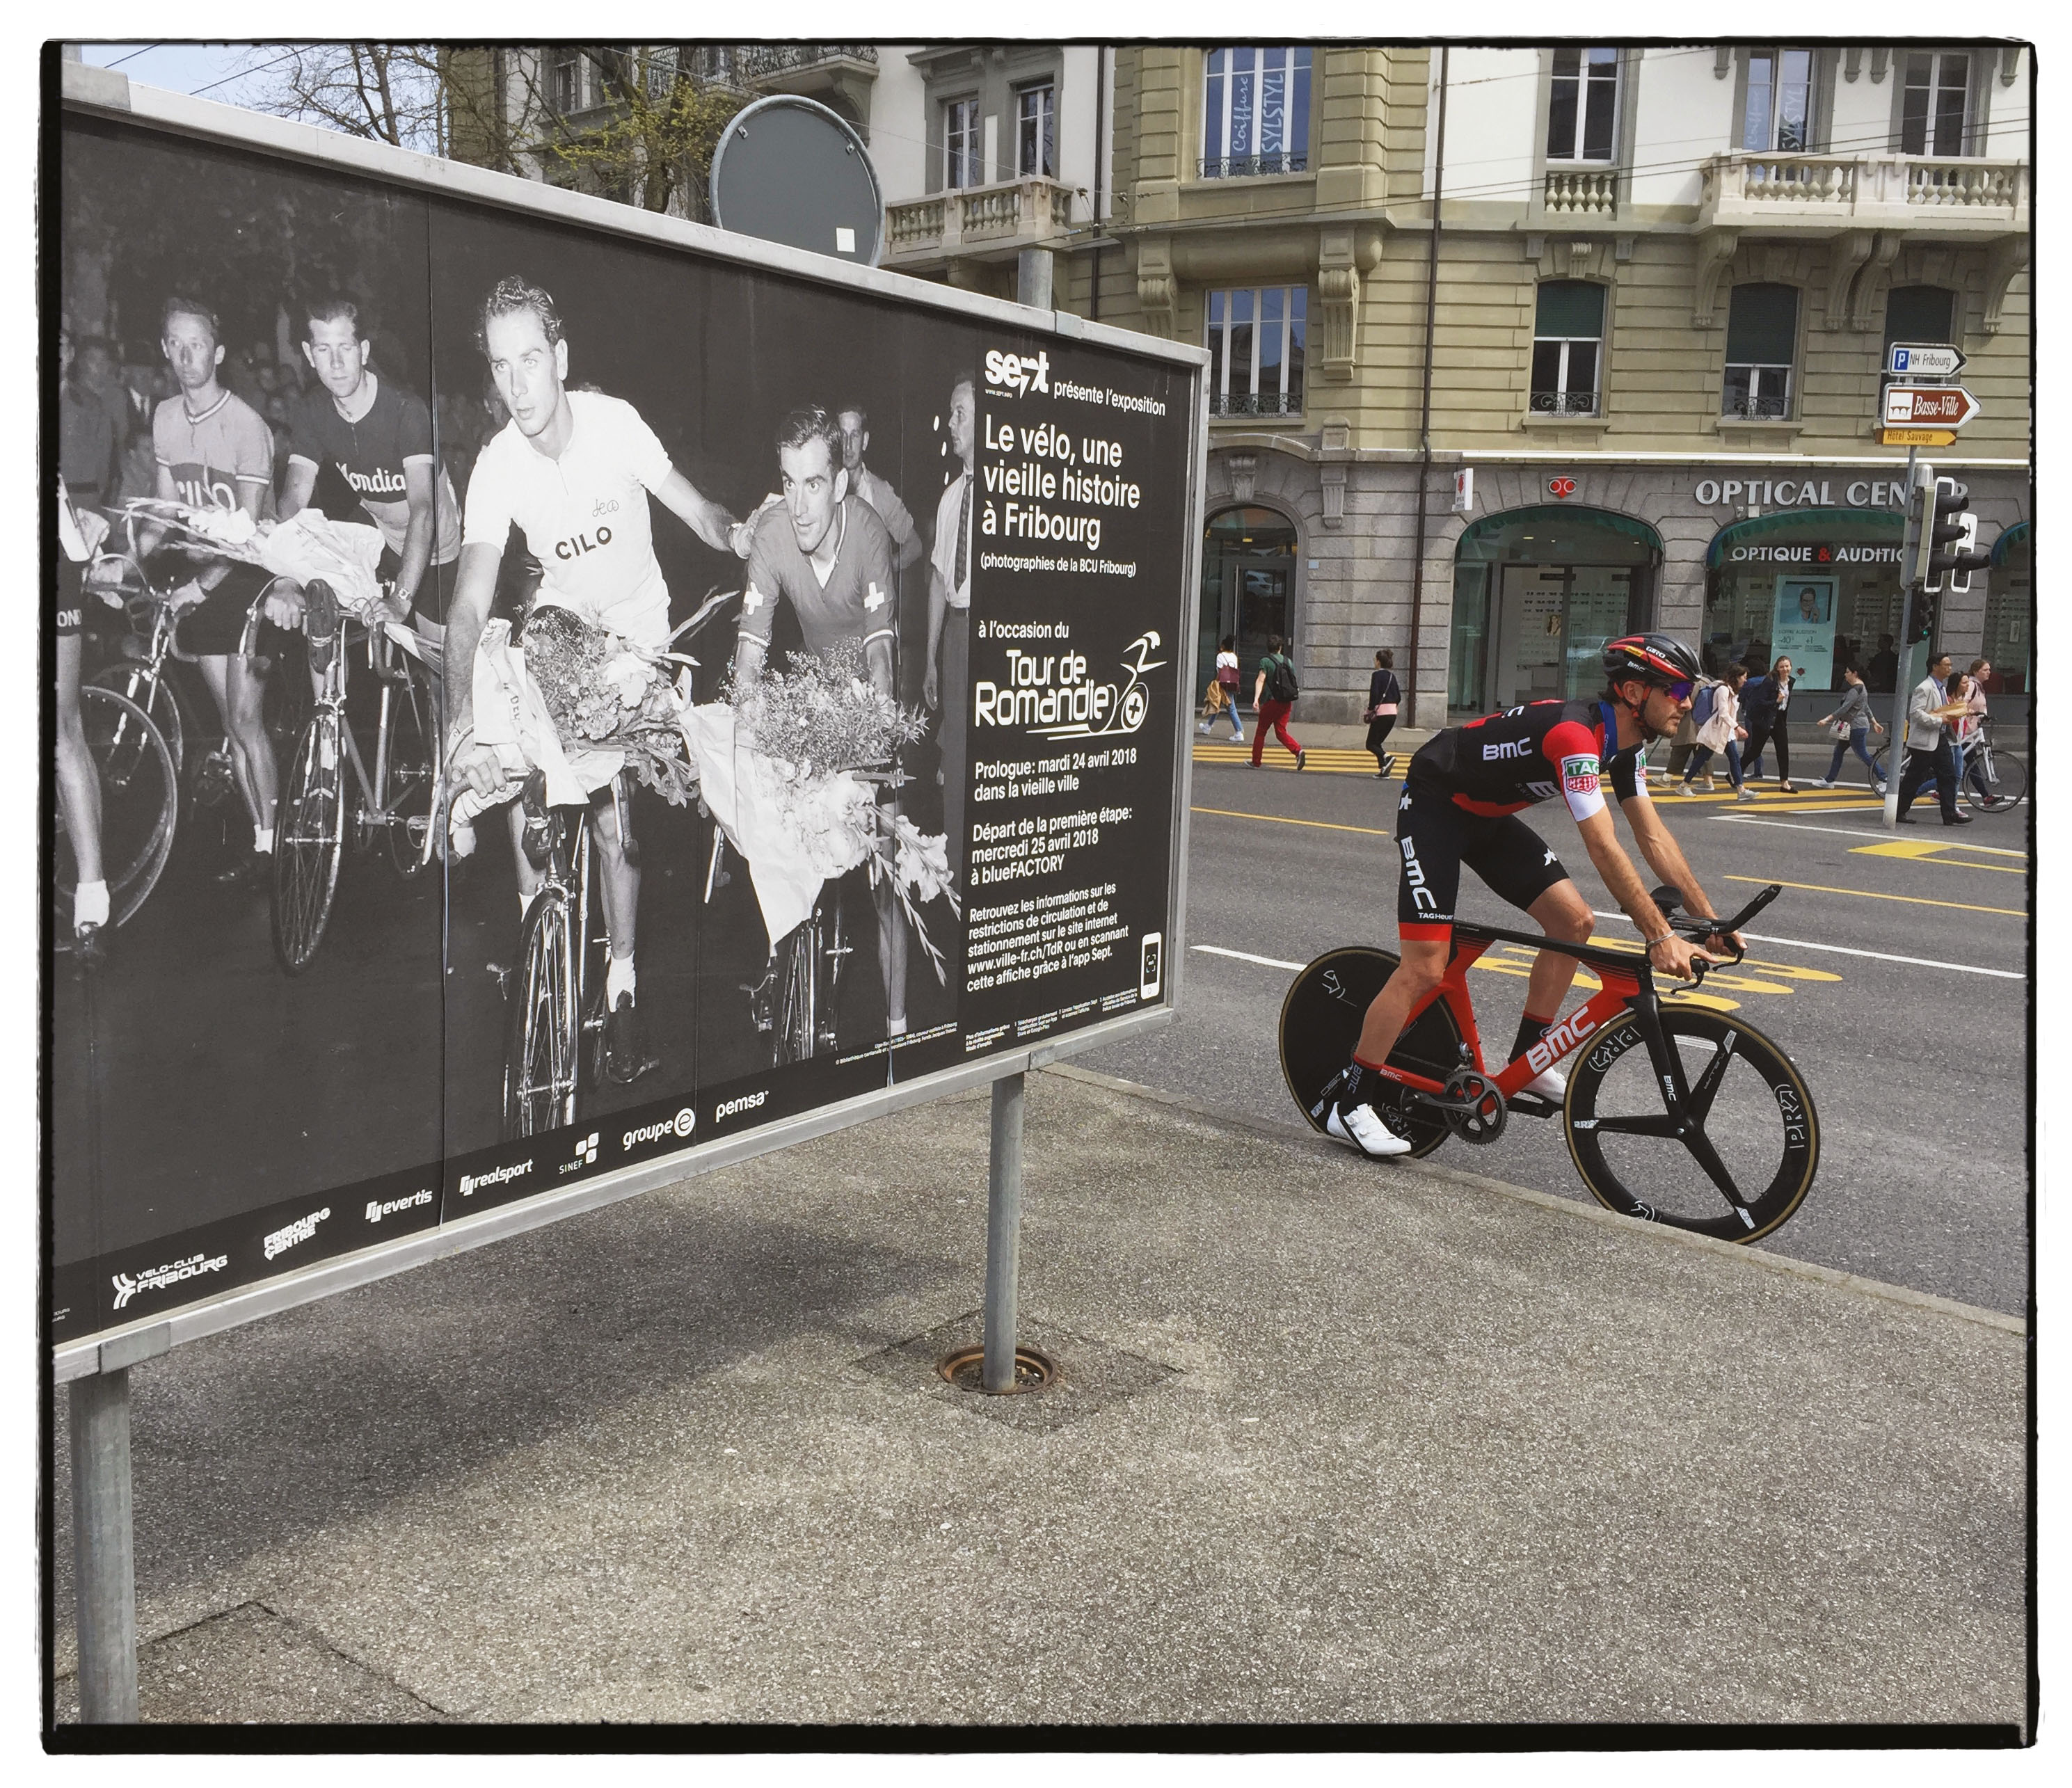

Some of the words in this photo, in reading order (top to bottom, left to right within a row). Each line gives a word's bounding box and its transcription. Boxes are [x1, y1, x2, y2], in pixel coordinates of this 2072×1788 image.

[1232, 77, 1252, 152] Coiffure
[1261, 73, 1284, 153] SYLSTYL
[1909, 353, 1920, 365] NH
[1922, 353, 1951, 369] Fribourg
[1054, 381, 1103, 404] présente
[1913, 395, 1960, 416] Basse-Ville
[985, 414, 1014, 452] Le
[1020, 423, 1076, 465] vélo,
[1083, 438, 1123, 467] une
[1887, 430, 1904, 440] Hôtel
[1907, 431, 1933, 444] Sauvage
[983, 459, 1056, 500] vieille
[1062, 468, 1140, 509] histoire
[1695, 479, 1835, 506] OPTICAL
[982, 500, 996, 535] à
[1005, 502, 1101, 550] Fribourg
[555, 527, 612, 560] CILO
[1732, 547, 1812, 561] OPTIQUE
[1819, 547, 1831, 561] &
[980, 552, 1055, 572] (photographies
[1057, 557, 1069, 571] de
[1070, 558, 1078, 572] la
[1080, 559, 1098, 573] BCU
[1099, 559, 1136, 578] Fribourg)
[978, 620, 987, 638] à
[1055, 621, 1069, 638] du
[1006, 649, 1055, 687] Tour
[1060, 649, 1087, 685] de
[1627, 661, 1645, 673] BMC
[1645, 646, 1666, 659] GIRO
[975, 679, 1110, 727] Romandie
[975, 760, 1036, 781] Prologue:
[1038, 754, 1070, 773] mardi
[1073, 752, 1085, 769] 24
[1087, 751, 1109, 768] avril
[1112, 747, 1137, 765] 2018
[1483, 737, 1533, 760] BMC
[974, 783, 1005, 801] dans
[1009, 781, 1019, 798] la
[1021, 777, 1055, 797] vieille
[1058, 774, 1079, 792] ville
[973, 820, 1016, 843] Départ
[1019, 817, 1034, 836] de
[1037, 816, 1047, 833] la
[1049, 810, 1097, 834] première
[1099, 806, 1133, 824] étape:
[971, 838, 1028, 863] mercredi
[1031, 836, 1045, 855] 25
[1048, 833, 1070, 852] avril
[1073, 828, 1099, 847] 2018
[971, 868, 979, 886] à
[982, 854, 1065, 884] blueFACTORY
[1401, 836, 1437, 910] BMC
[969, 902, 1019, 923] Retrouvez
[1021, 898, 1035, 911] les
[1036, 887, 1089, 911] informations
[1090, 886, 1103, 897] sur
[1104, 882, 1116, 895] les
[968, 932, 1040, 958] stationnement
[1042, 927, 1055, 942] sur
[1058, 924, 1066, 938] le
[1068, 919, 1083, 935] site
[1085, 912, 1118, 932] internet
[969, 917, 1024, 940] restrictions
[1026, 913, 1039, 928] de
[1040, 905, 1086, 926] circulation
[1087, 902, 1096, 915] et
[1097, 900, 1108, 913] de
[967, 943, 1062, 975] www.ville-fr.ch/TdR
[1065, 939, 1076, 953] ou
[1078, 936, 1089, 950] en
[1090, 925, 1129, 946] scannant
[967, 971, 994, 992] cette
[996, 967, 1030, 986] affiche
[1033, 958, 1059, 980] grâce
[1061, 955, 1067, 969] à
[1092, 944, 1113, 962] Sept.
[1526, 1005, 1596, 1074] BMC
[1348, 1064, 1363, 1094] BMC
[1380, 1068, 1403, 1081] BMC
[1664, 1075, 1677, 1102] BMC
[474, 1158, 533, 1188] realsport
[559, 1159, 583, 1174] SINEF
[383, 1189, 432, 1215] evertis
[263, 1207, 330, 1248] FRIBOURG
[264, 1224, 316, 1261] CENTRE
[136, 1253, 205, 1280] VELO-CLUB
[137, 1254, 228, 1293] FRIBOURG
